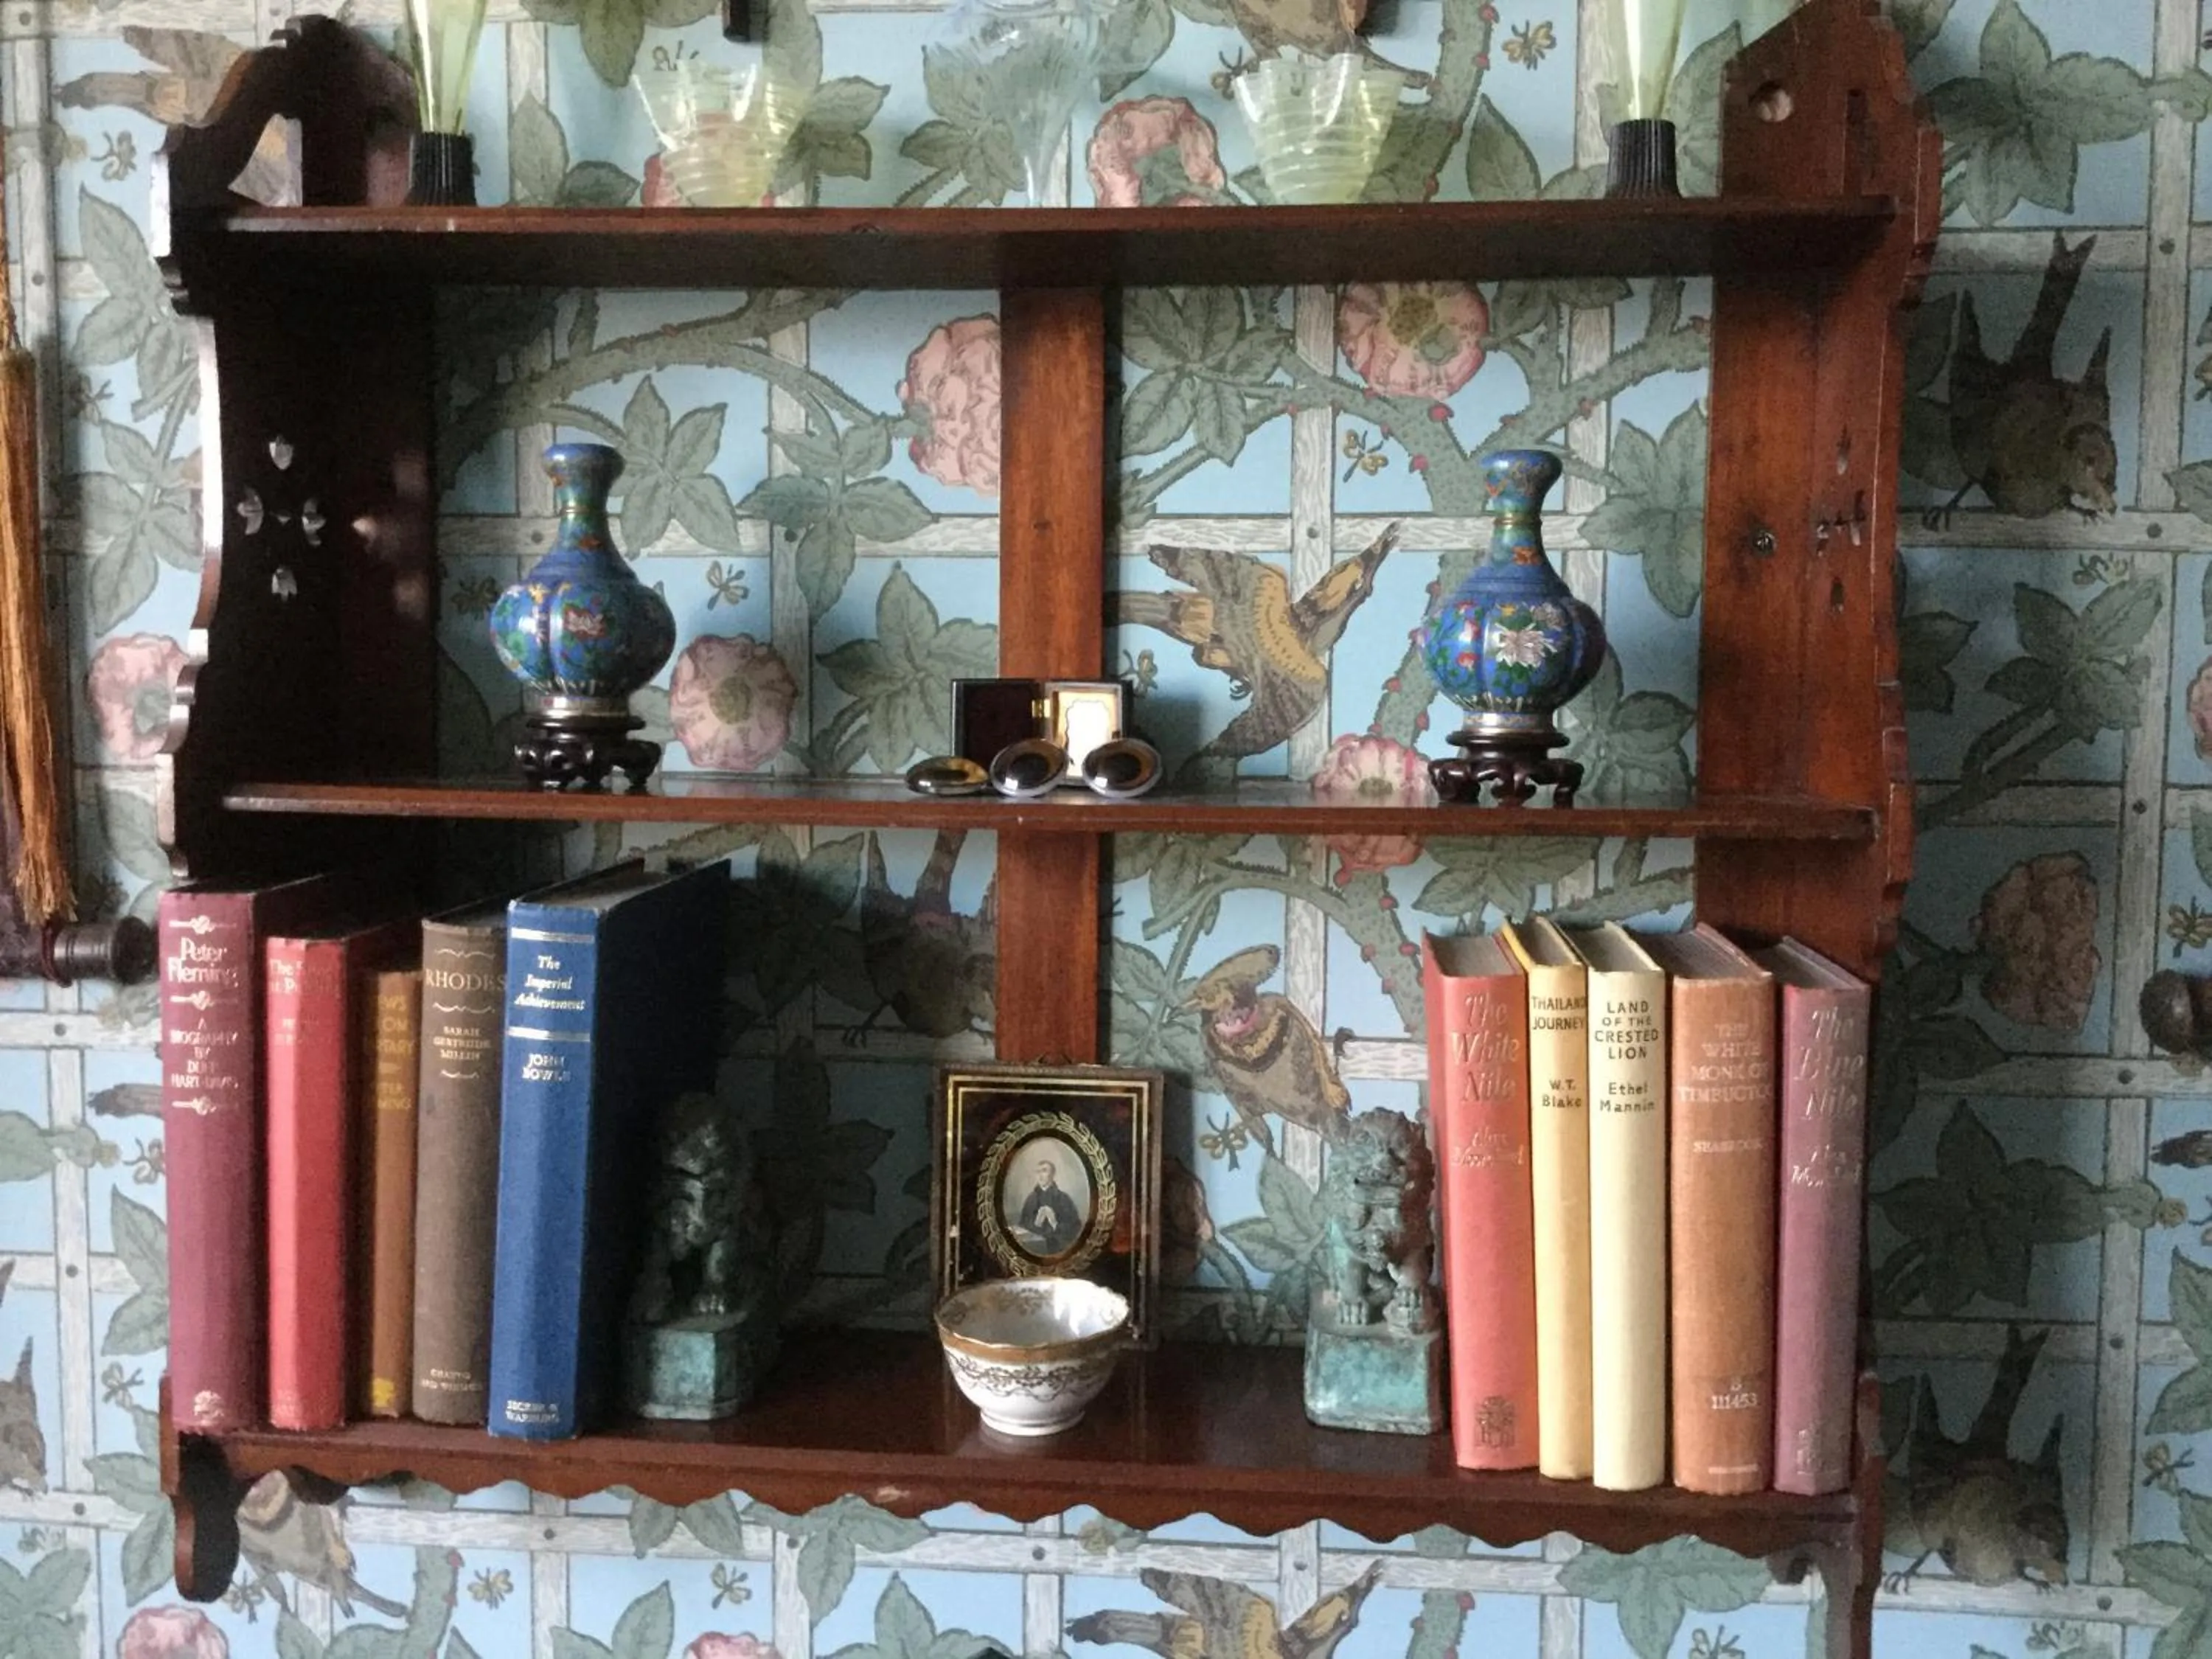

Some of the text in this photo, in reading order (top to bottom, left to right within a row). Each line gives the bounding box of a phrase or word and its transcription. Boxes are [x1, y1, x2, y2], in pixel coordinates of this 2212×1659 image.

[180, 937, 228, 962] Peter
[538, 955, 562, 970] The
[167, 956, 239, 987] Fleming
[425, 968, 507, 991] RHODES
[524, 973, 574, 992] Imperial
[513, 992, 586, 1011] Achievement
[1531, 995, 1587, 1012] THAILAND
[1607, 1001, 1649, 1015] LAND
[1465, 992, 1508, 1029] The
[1531, 1017, 1585, 1031] JOURNEY
[1602, 1015, 1652, 1027] OF THE
[1810, 1006, 1854, 1040] The
[1594, 1029, 1660, 1043] CRESTED
[1714, 1023, 1748, 1037] THE
[1450, 1031, 1520, 1066] White
[1608, 1046, 1648, 1060] LION
[1702, 1042, 1761, 1057] WHITE
[527, 1053, 566, 1068] JOHN
[1691, 1062, 1745, 1081] MONK
[1461, 1069, 1517, 1102] Nile
[1549, 1079, 1576, 1091] W.T.
[1608, 1082, 1648, 1096] Ethel
[1542, 1095, 1582, 1108] Blake
[1599, 1099, 1655, 1113] Mannin
[1800, 1085, 1857, 1121] Nile
